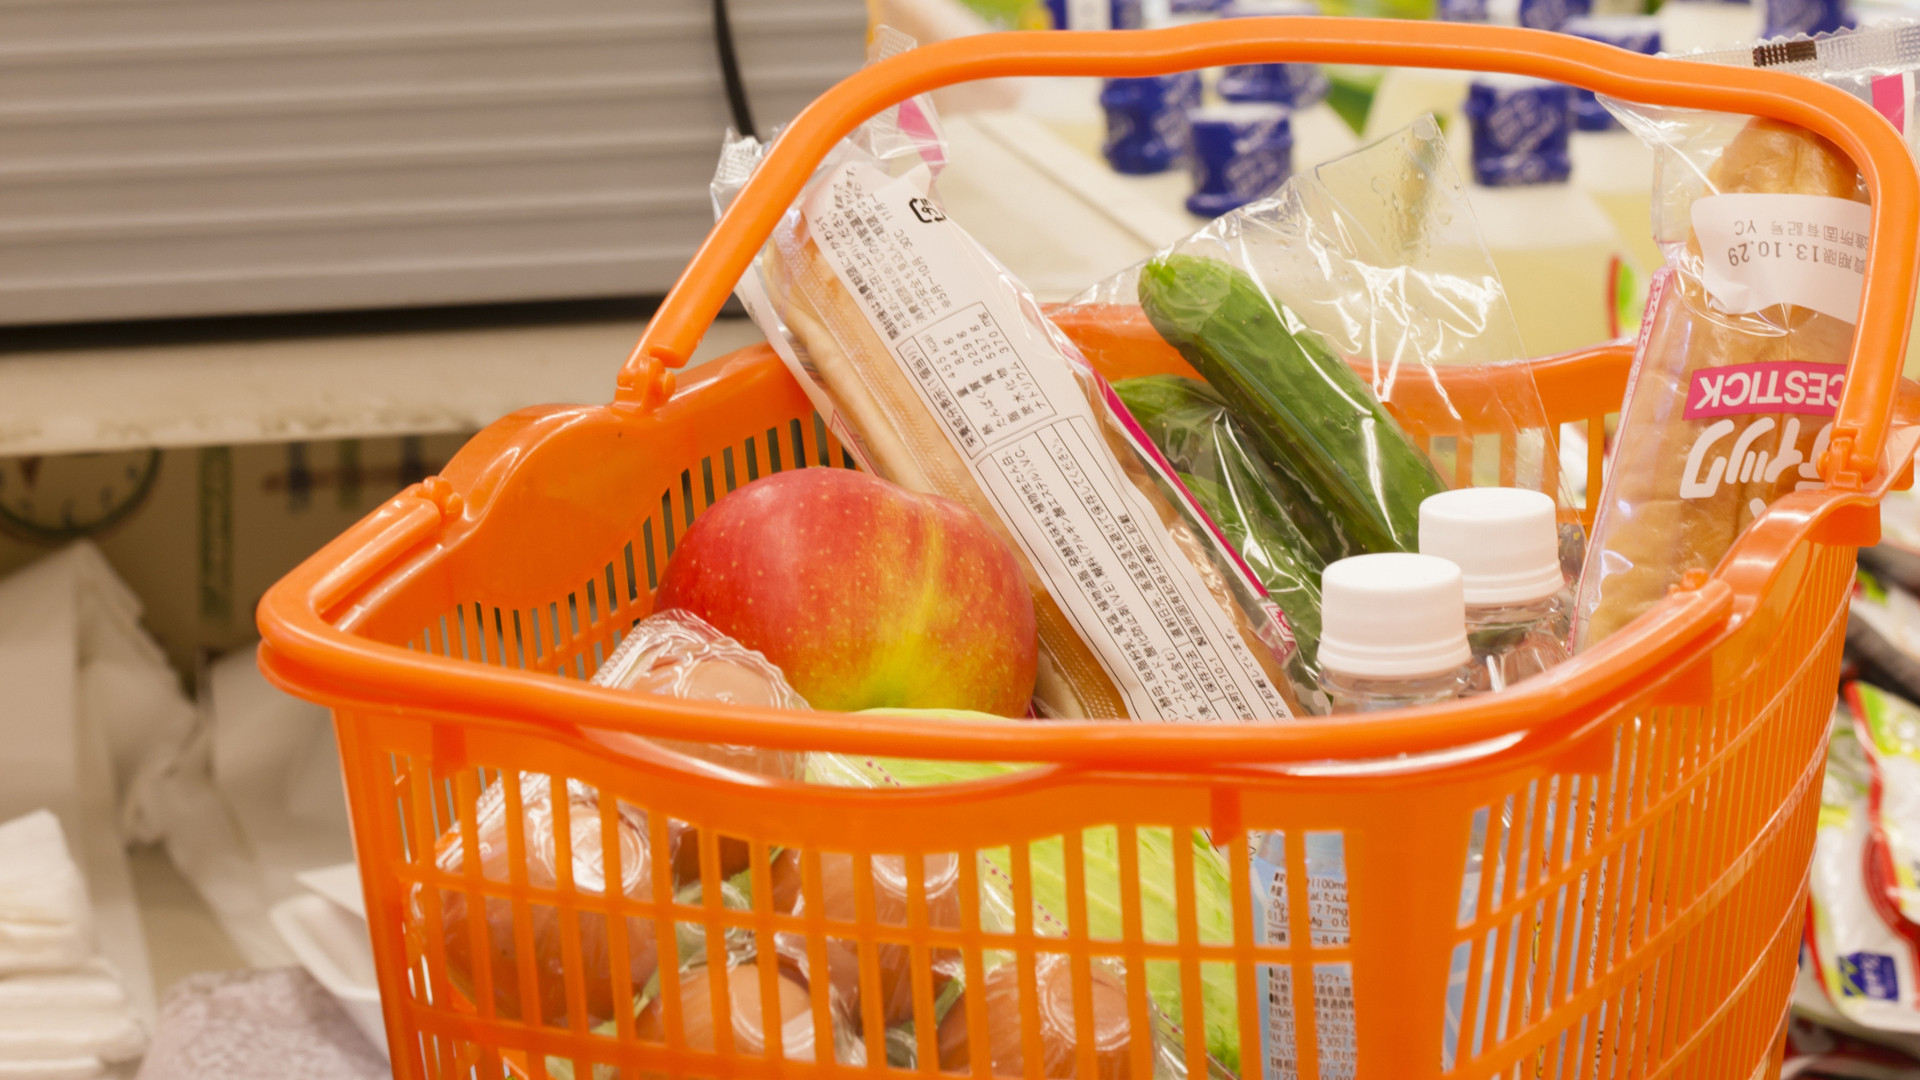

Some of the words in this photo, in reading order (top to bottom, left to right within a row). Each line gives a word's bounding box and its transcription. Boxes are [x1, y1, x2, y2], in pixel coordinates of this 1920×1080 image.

[1733, 219, 1756, 236] YC
[1009, 360, 1046, 410] ナトリウム
[1182, 648, 1218, 695] 保存方法
